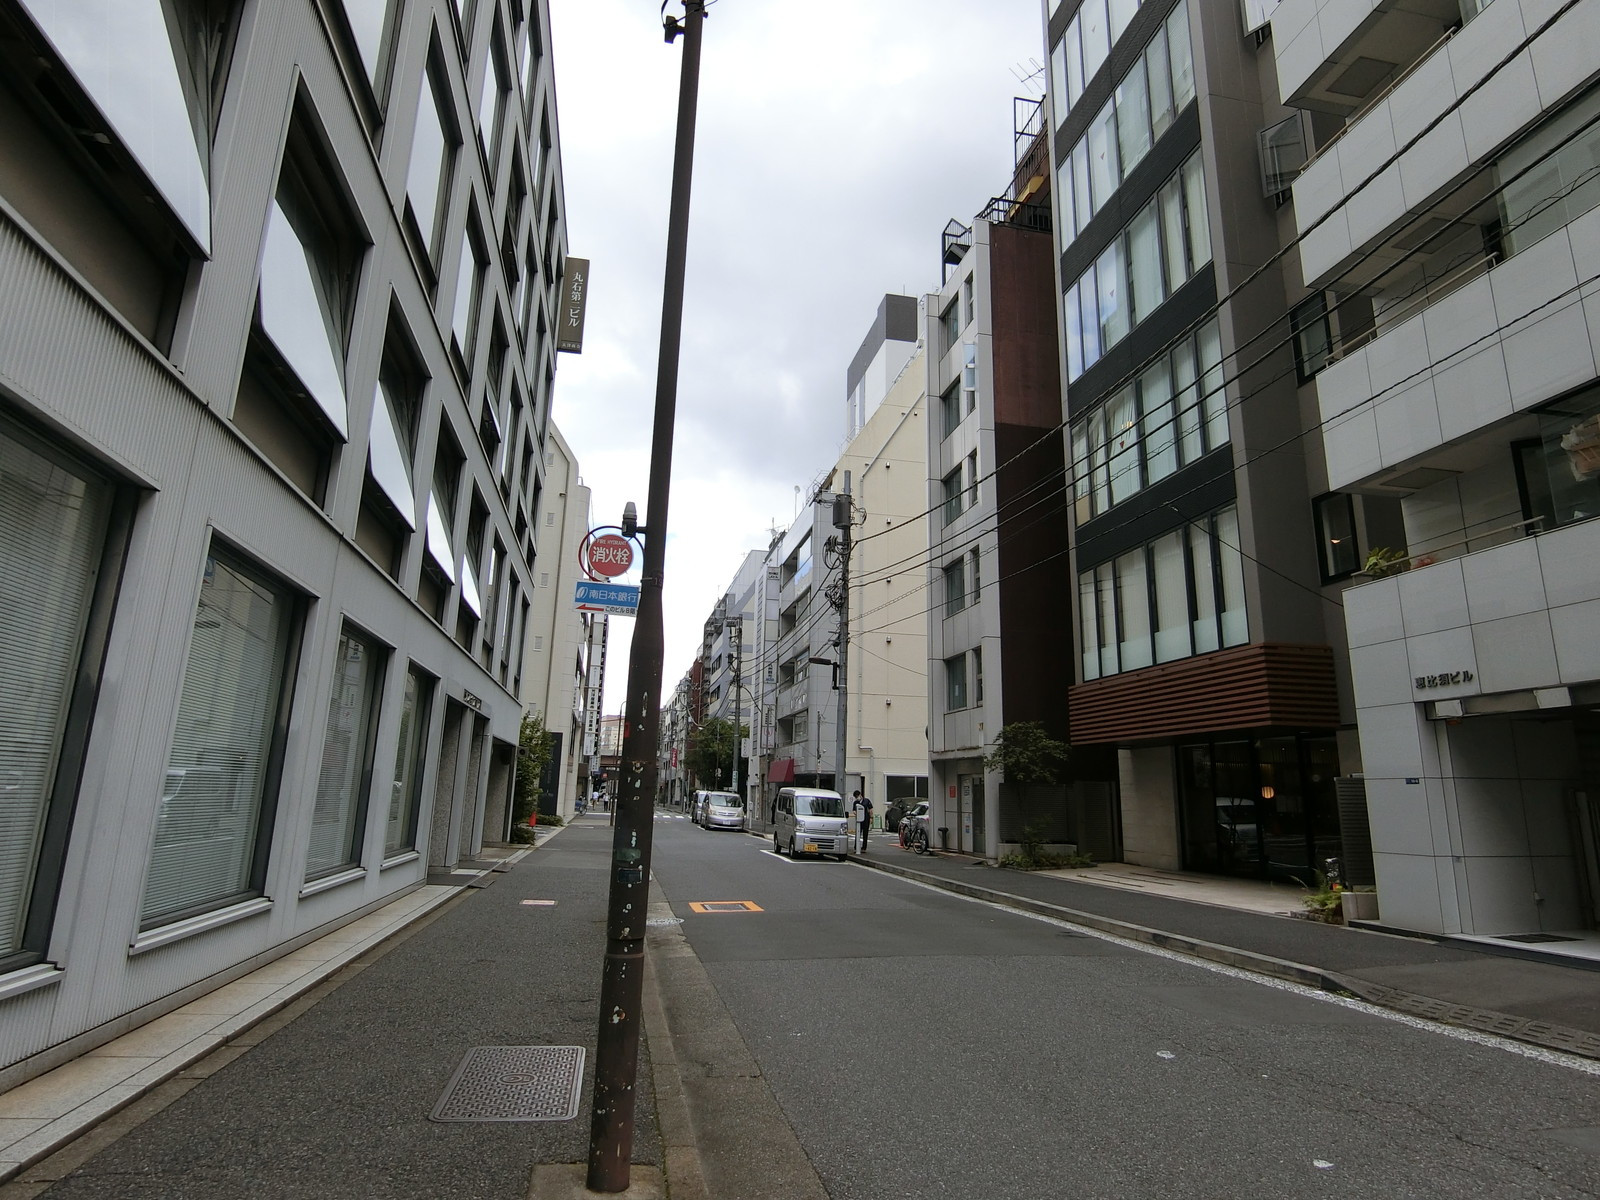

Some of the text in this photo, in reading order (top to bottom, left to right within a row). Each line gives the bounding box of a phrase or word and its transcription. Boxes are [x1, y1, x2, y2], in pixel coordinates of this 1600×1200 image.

[568, 272, 583, 327] 丸石第二ビル
[592, 546, 630, 564] 消火栓
[589, 590, 637, 602] 南日本銀行
[1415, 670, 1473, 689] 恵比須ビル
